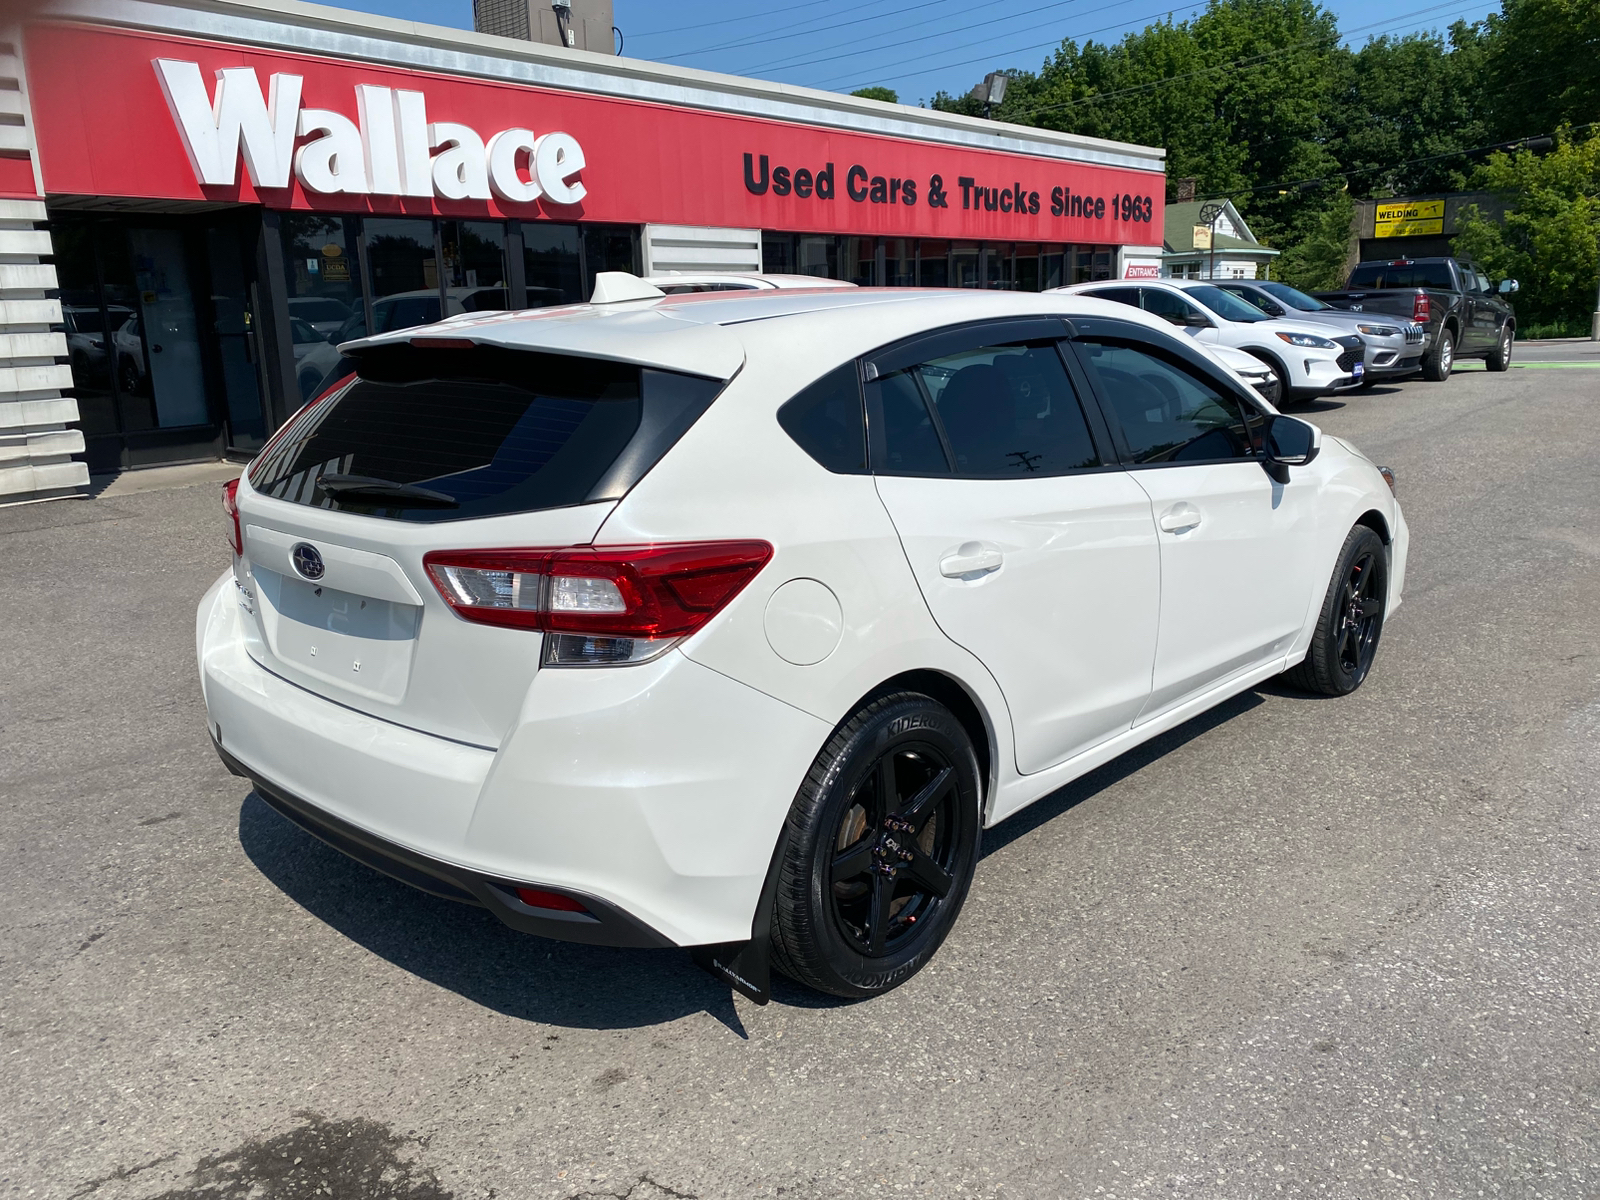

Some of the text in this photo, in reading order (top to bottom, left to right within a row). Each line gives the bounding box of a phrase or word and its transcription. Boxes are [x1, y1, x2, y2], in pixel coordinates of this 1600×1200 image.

[150, 57, 588, 204] Wallace
[743, 152, 1153, 223] Used Cars & Trucks Since 1963
[1379, 209, 1419, 219] WELDING
[1128, 267, 1159, 277] ENTRANCE
